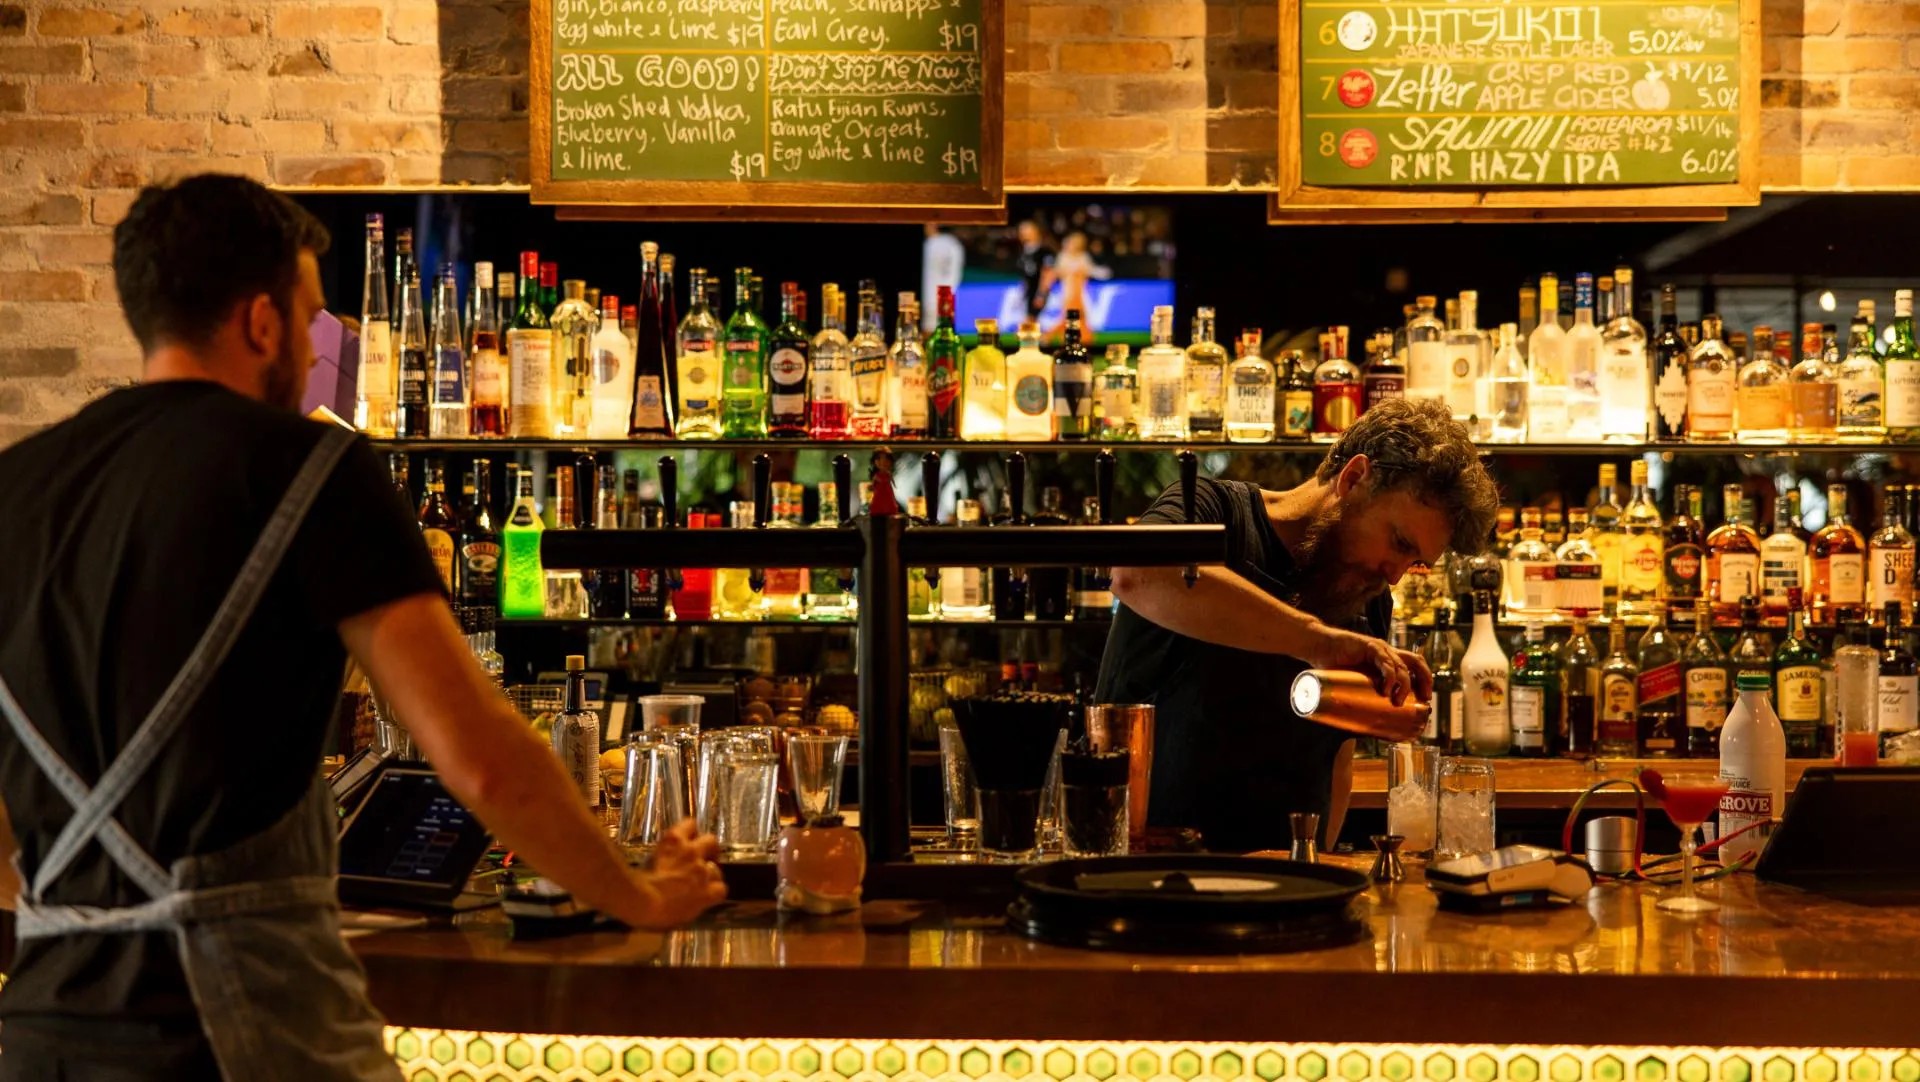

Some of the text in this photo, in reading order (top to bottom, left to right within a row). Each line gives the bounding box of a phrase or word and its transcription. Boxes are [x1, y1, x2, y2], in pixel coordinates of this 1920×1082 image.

[558, 23, 588, 46] egg
[592, 17, 645, 39] white
[669, 16, 720, 40] lime
[726, 22, 765, 48] $19
[775, 18, 818, 43] Earl
[938, 19, 979, 51] $19
[1318, 19, 1337, 46] 6
[1395, 41, 1616, 60] JAPANESE STYLE LAGER
[557, 53, 624, 91] ALL
[833, 58, 877, 85] Stop
[881, 57, 911, 79] Me
[917, 61, 961, 80] Now
[1487, 62, 1630, 86] CRISP RED
[1319, 76, 1336, 102] 7
[1372, 64, 1477, 112] Zeffer
[1475, 82, 1634, 112] APPLE CIDER
[556, 93, 751, 124] Broken Shed Vodka,
[772, 97, 822, 119] Ratu
[663, 120, 736, 144] Vanilla
[1571, 115, 1673, 136] AOTEAROA
[1319, 131, 1337, 157] 8
[1563, 134, 1623, 152] SERIES
[729, 150, 767, 182] $19
[773, 141, 803, 172] Egg
[808, 138, 854, 161] white
[881, 143, 926, 164] lime
[941, 142, 980, 177] $19
[1470, 149, 1551, 183] HAZY
[1563, 150, 1621, 184] IPA
[1681, 147, 1738, 174] 6.0%
[1243, 411, 1261, 424] GIN
[1720, 795, 1770, 813] GROVE
